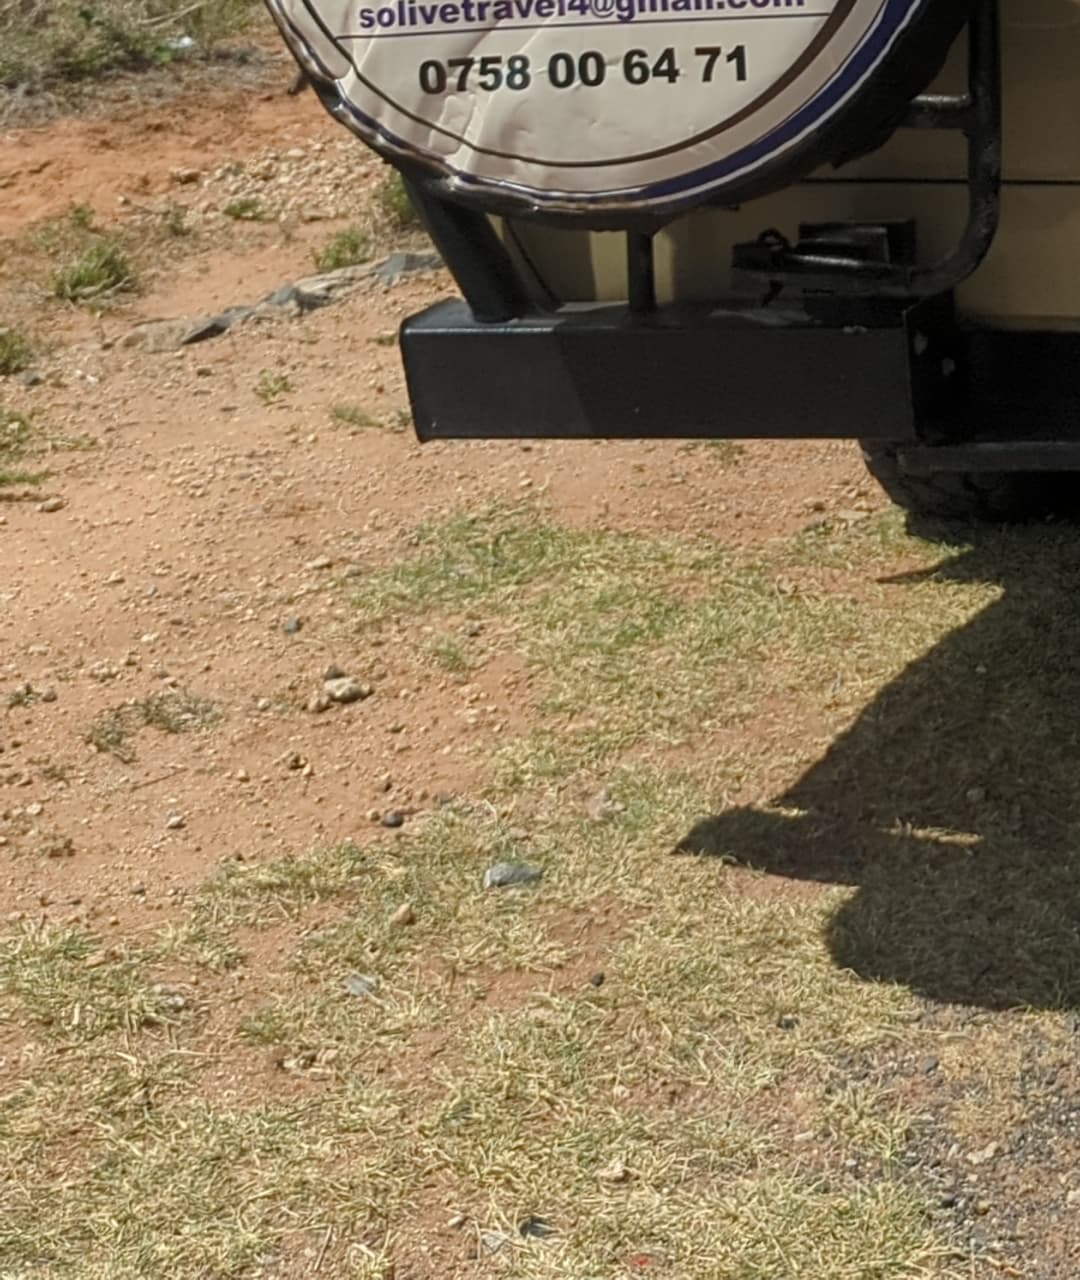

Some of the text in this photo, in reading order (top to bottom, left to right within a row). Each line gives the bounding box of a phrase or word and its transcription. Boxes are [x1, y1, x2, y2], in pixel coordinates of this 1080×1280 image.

[419, 45, 747, 95] 0758 00 64 71
